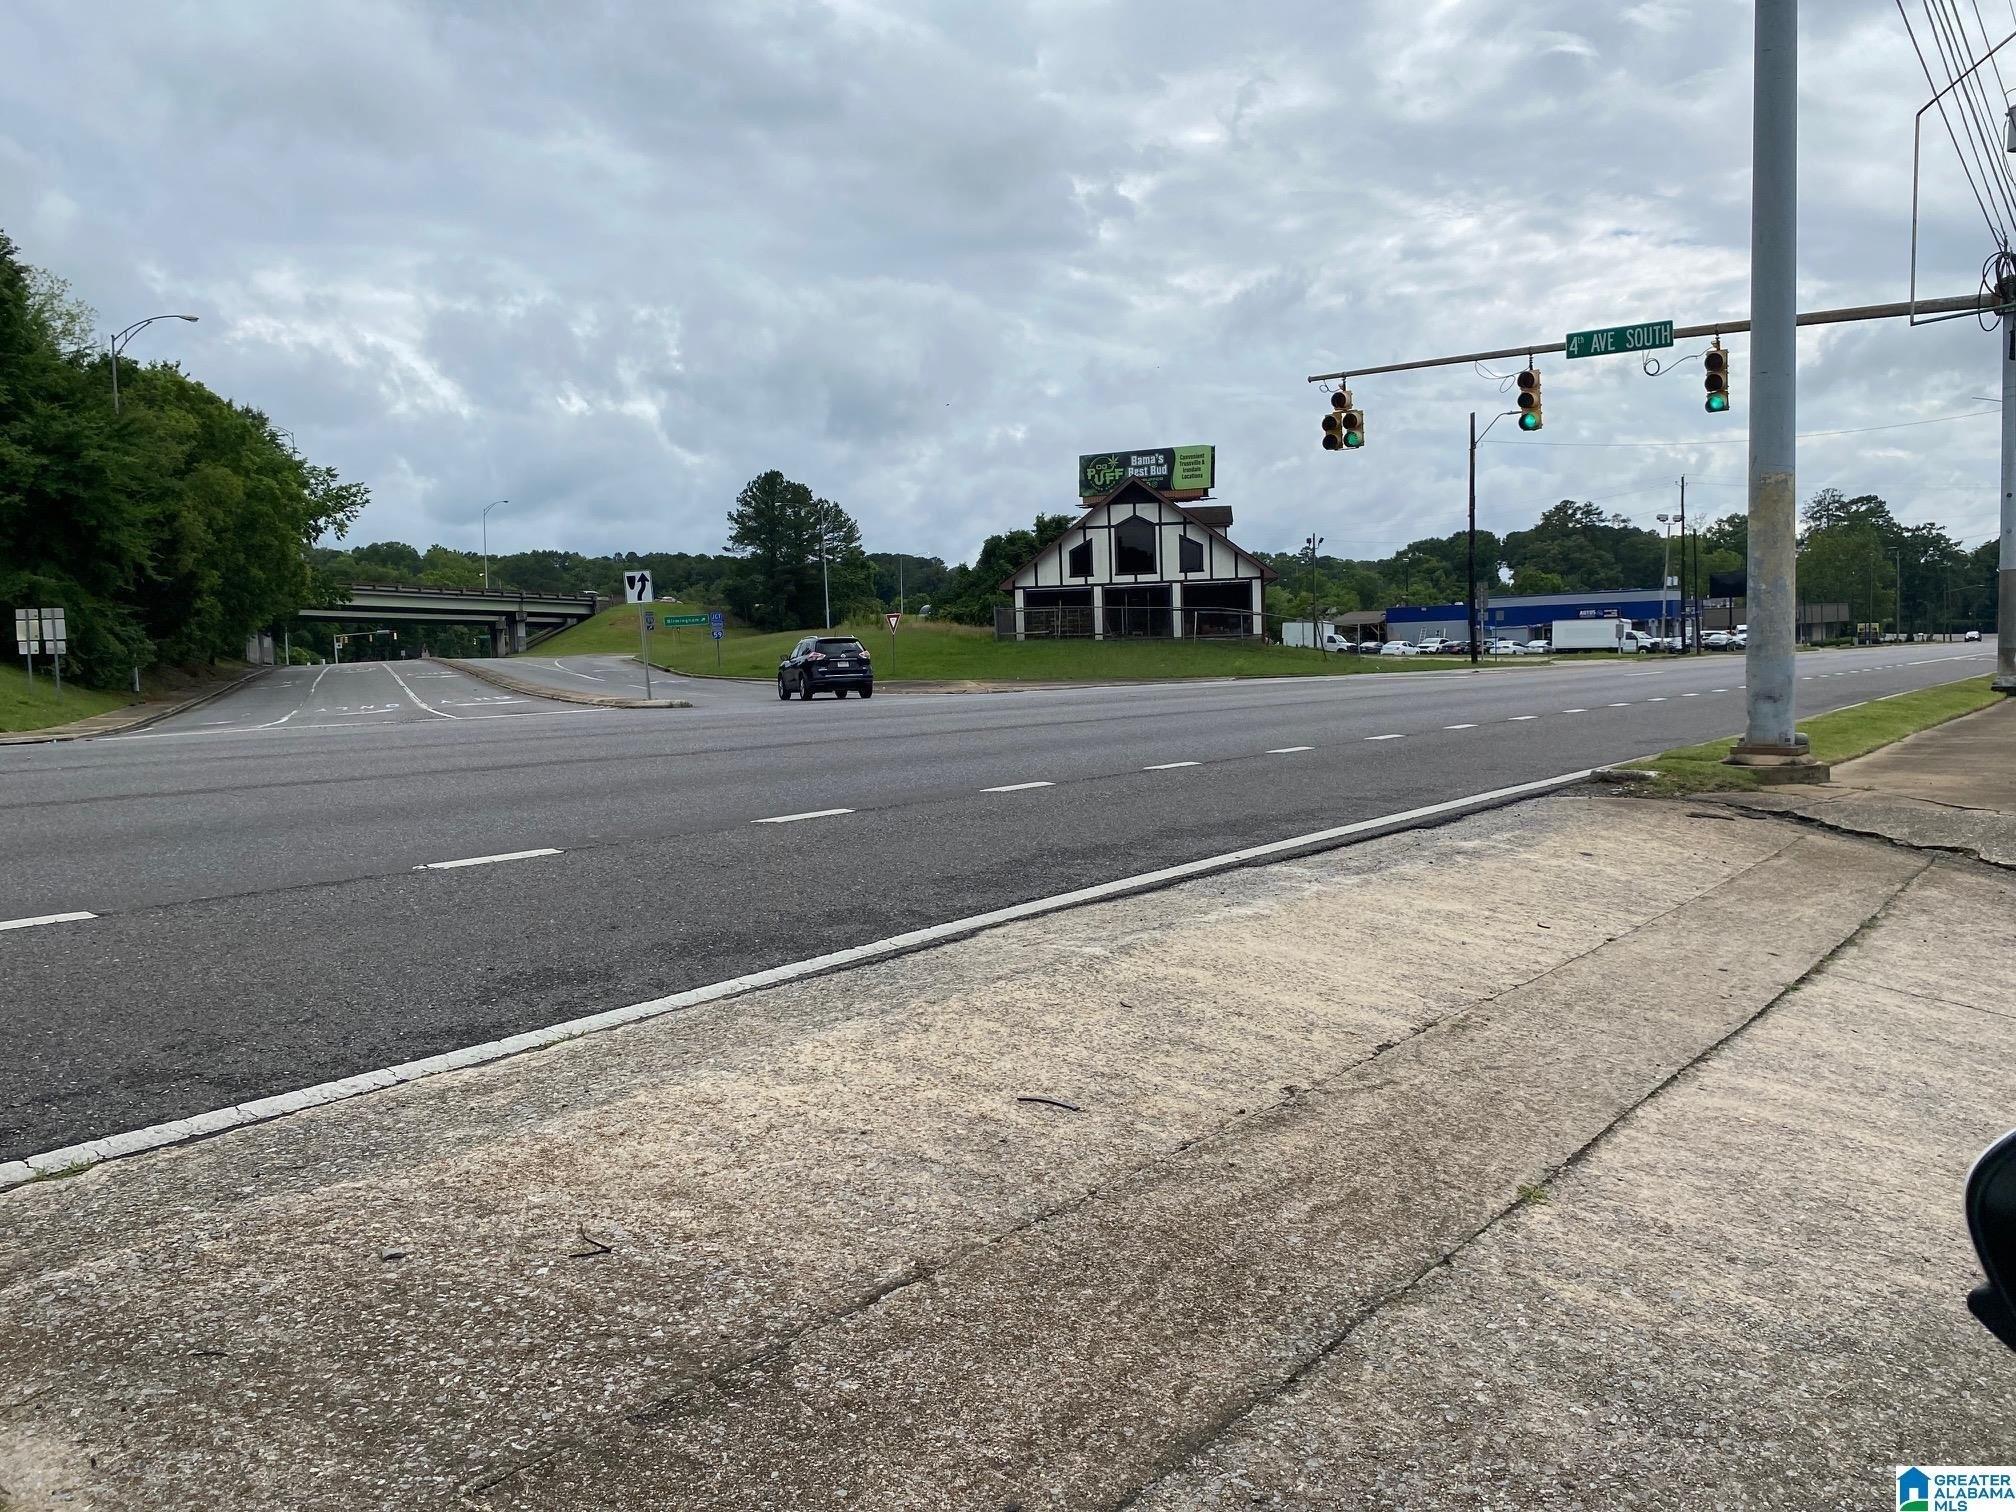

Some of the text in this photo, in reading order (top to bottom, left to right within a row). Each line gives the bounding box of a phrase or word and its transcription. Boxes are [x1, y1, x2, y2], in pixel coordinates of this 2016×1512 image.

[1569, 325, 1671, 355] 4th AVE SOUTH
[1131, 453, 1164, 466] Bama's
[1087, 467, 1124, 486] PUFF
[1128, 463, 1168, 477] Best Bud
